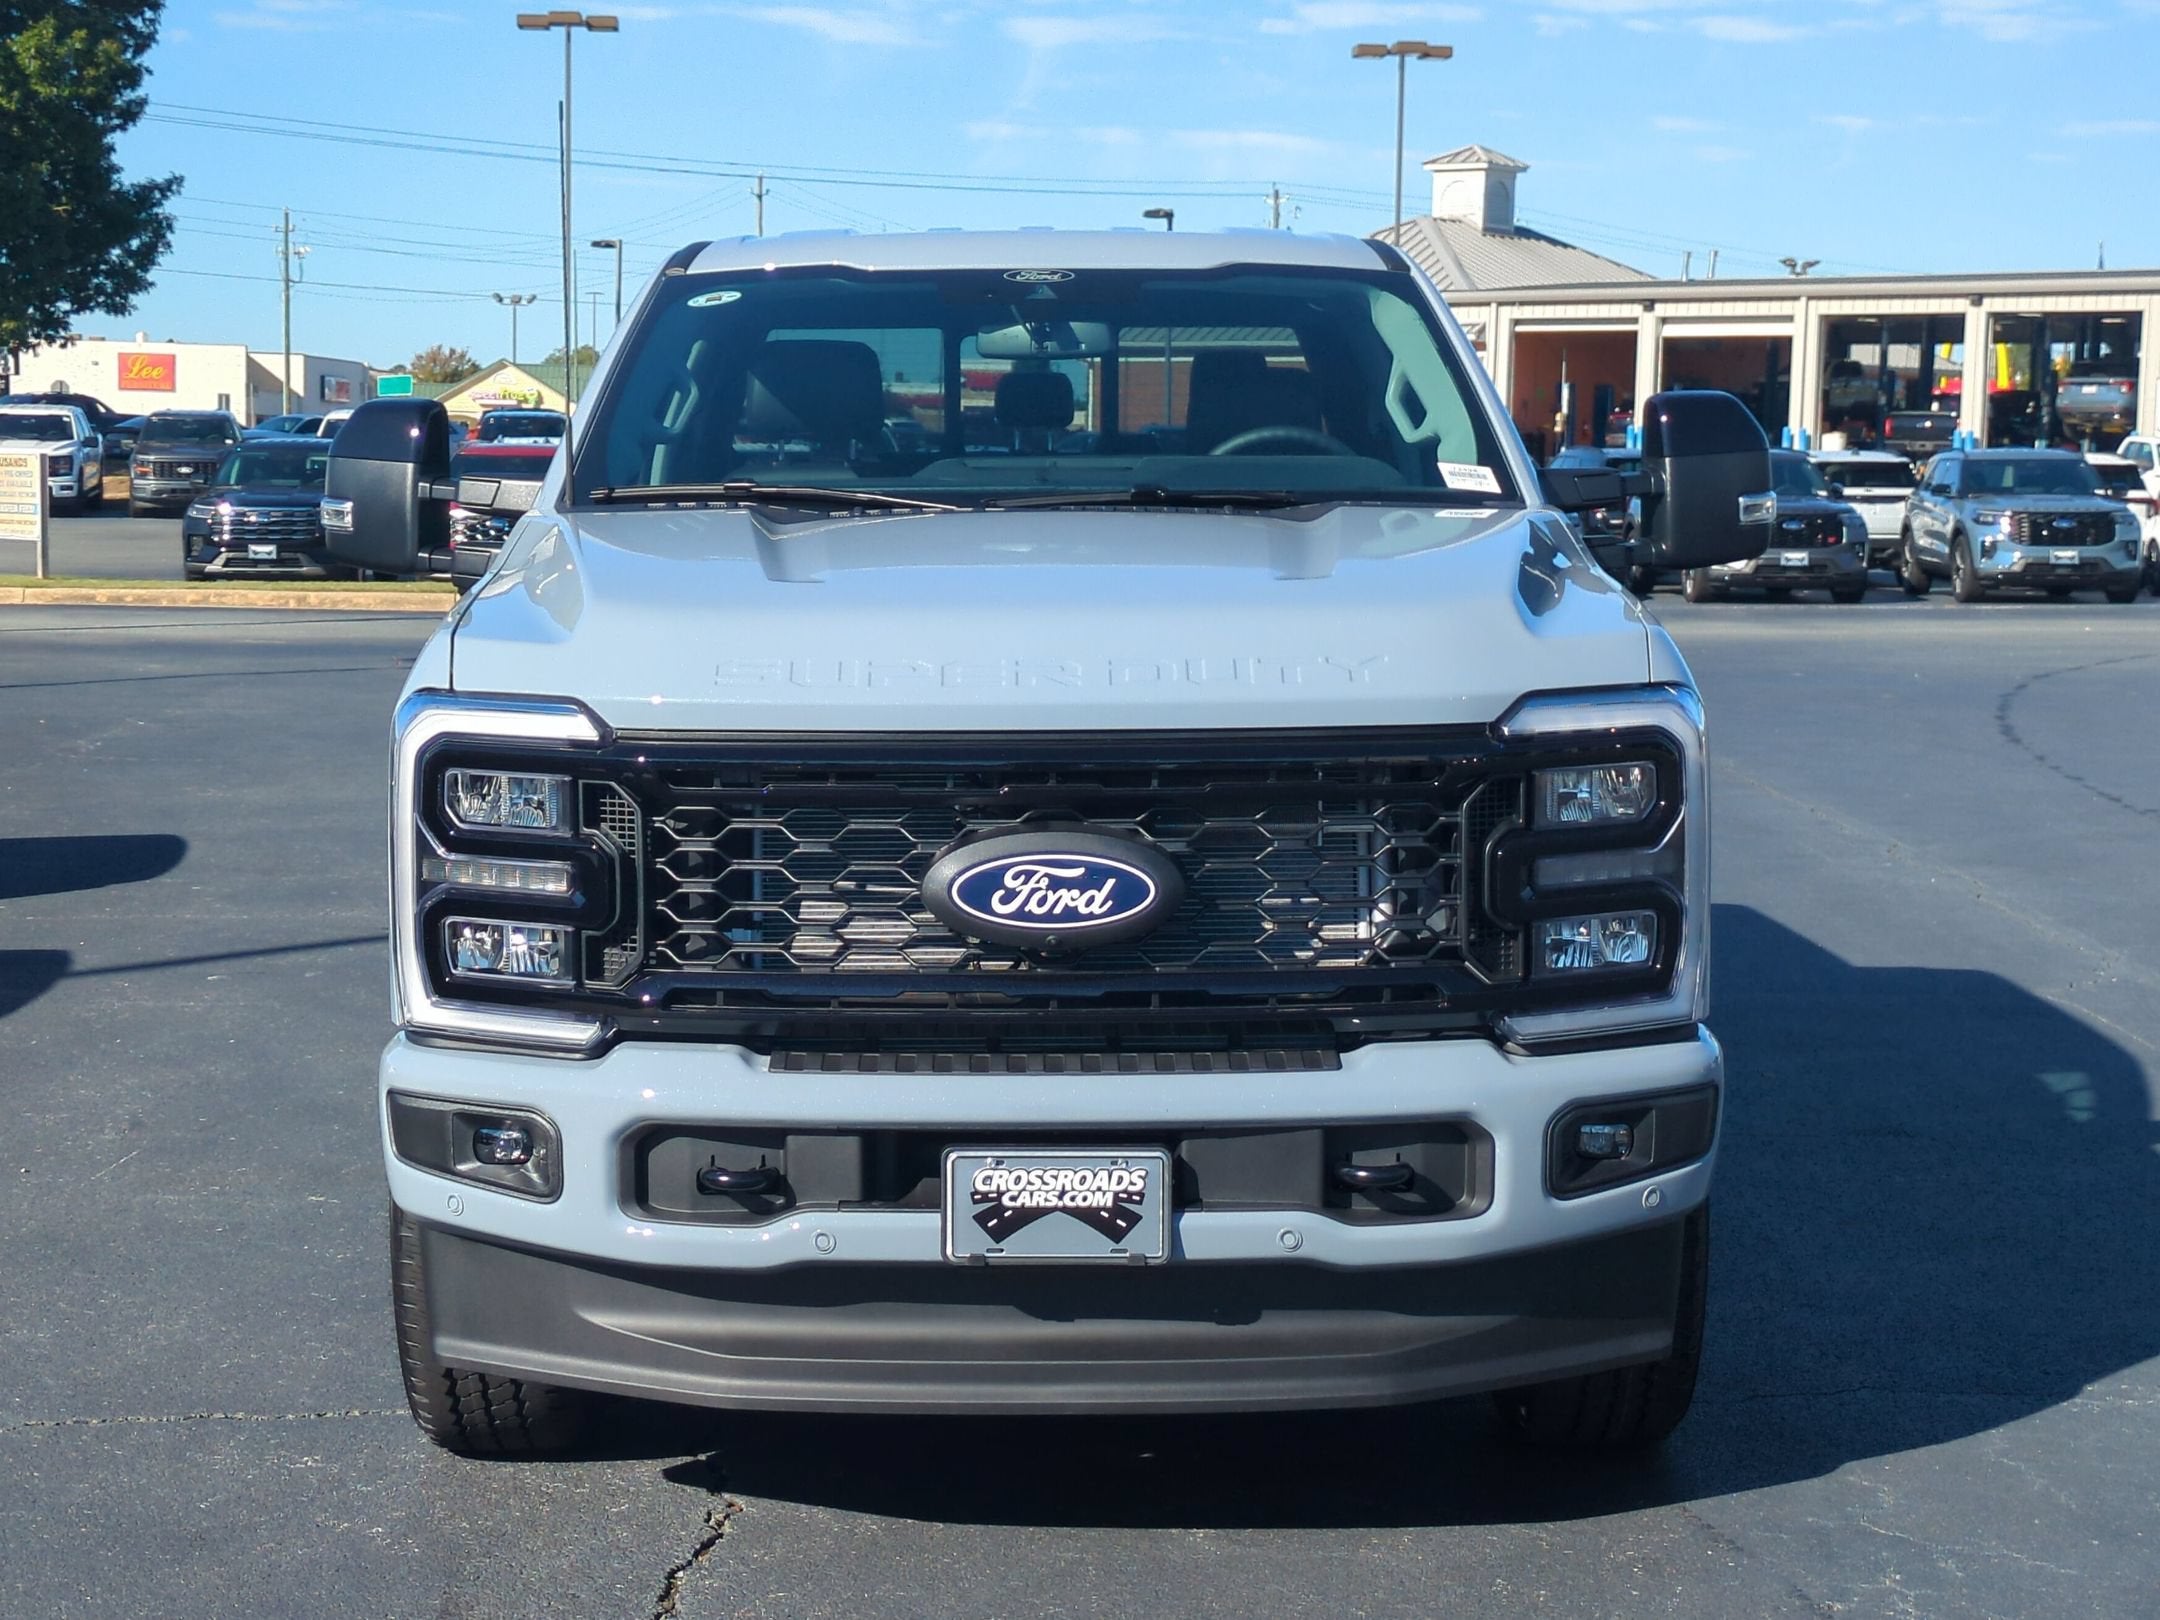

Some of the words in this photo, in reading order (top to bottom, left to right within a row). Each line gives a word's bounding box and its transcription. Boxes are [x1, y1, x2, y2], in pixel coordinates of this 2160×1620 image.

[1015, 271, 1062, 280] Ford
[123, 355, 166, 379] Lee
[714, 659, 1082, 687] SUPER
[1108, 656, 1388, 686] DUTY
[991, 864, 1117, 915] Ford
[973, 1166, 1148, 1193] CROSSROADS
[1001, 1190, 1114, 1209] CARS.COM
